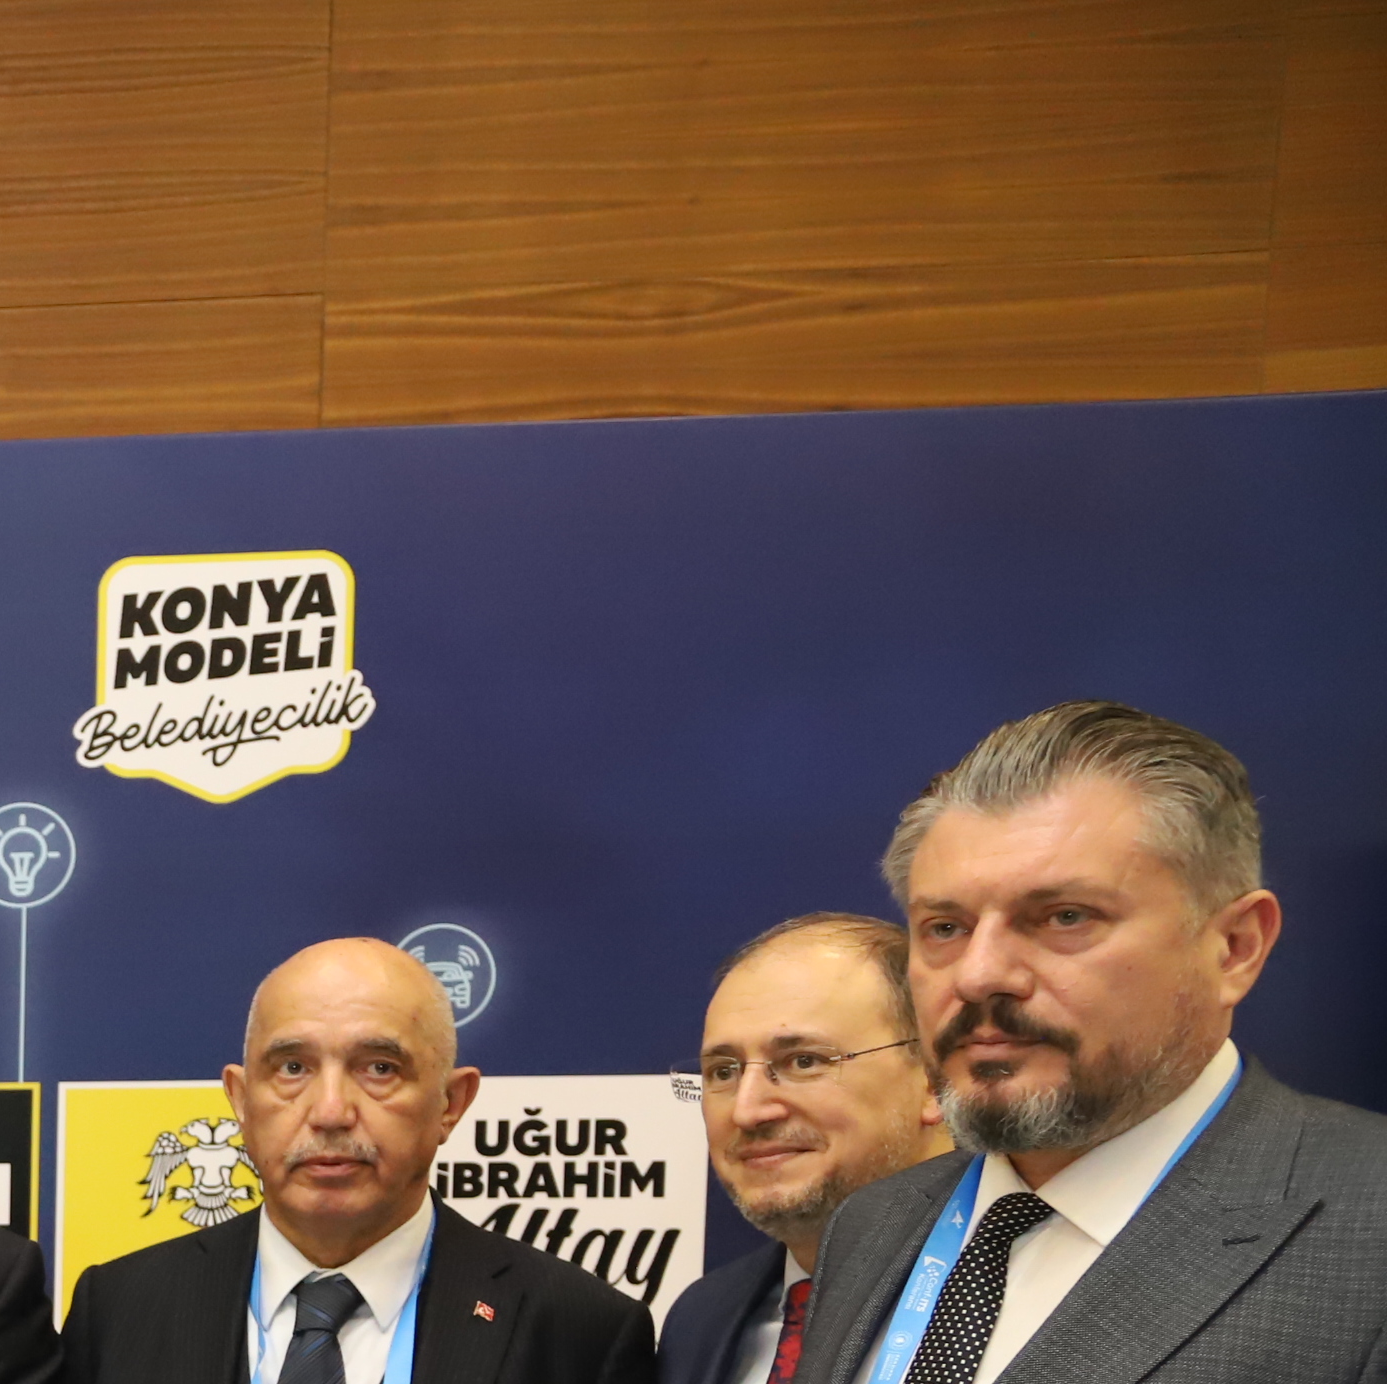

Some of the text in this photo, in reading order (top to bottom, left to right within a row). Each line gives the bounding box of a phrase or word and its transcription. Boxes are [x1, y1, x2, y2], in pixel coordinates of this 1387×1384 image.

[119, 573, 336, 639] KONYA
[81, 677, 368, 766] Belediyecilik
[475, 1107, 628, 1157] UĞUR
